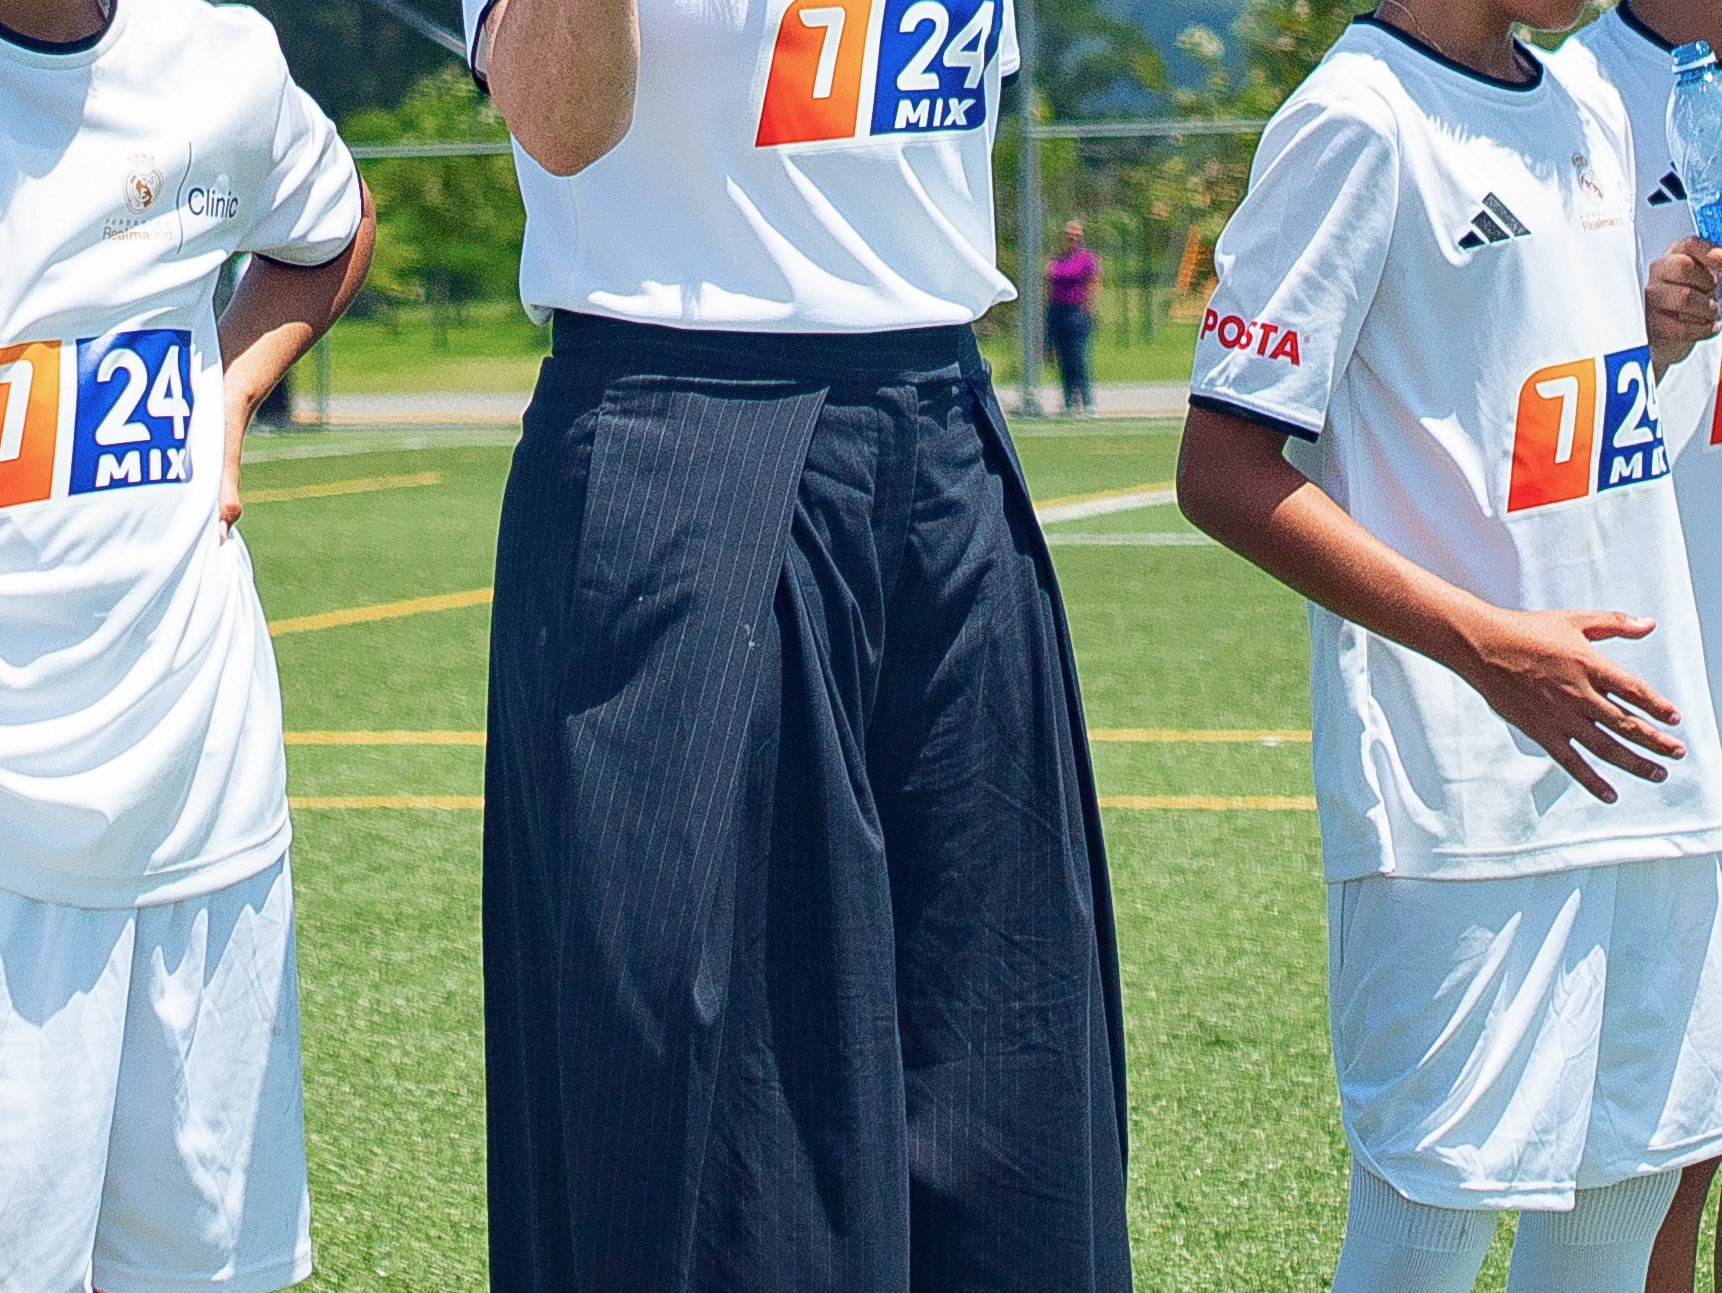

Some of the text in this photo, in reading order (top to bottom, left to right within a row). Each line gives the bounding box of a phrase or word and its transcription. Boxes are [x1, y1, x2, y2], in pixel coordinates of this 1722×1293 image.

[896, 0, 995, 91] 24
[894, 98, 977, 130] MIX
[187, 187, 239, 219] Clinic
[1199, 307, 1301, 367] POSTA
[94, 345, 191, 447] 24
[94, 448, 188, 488] MIX
